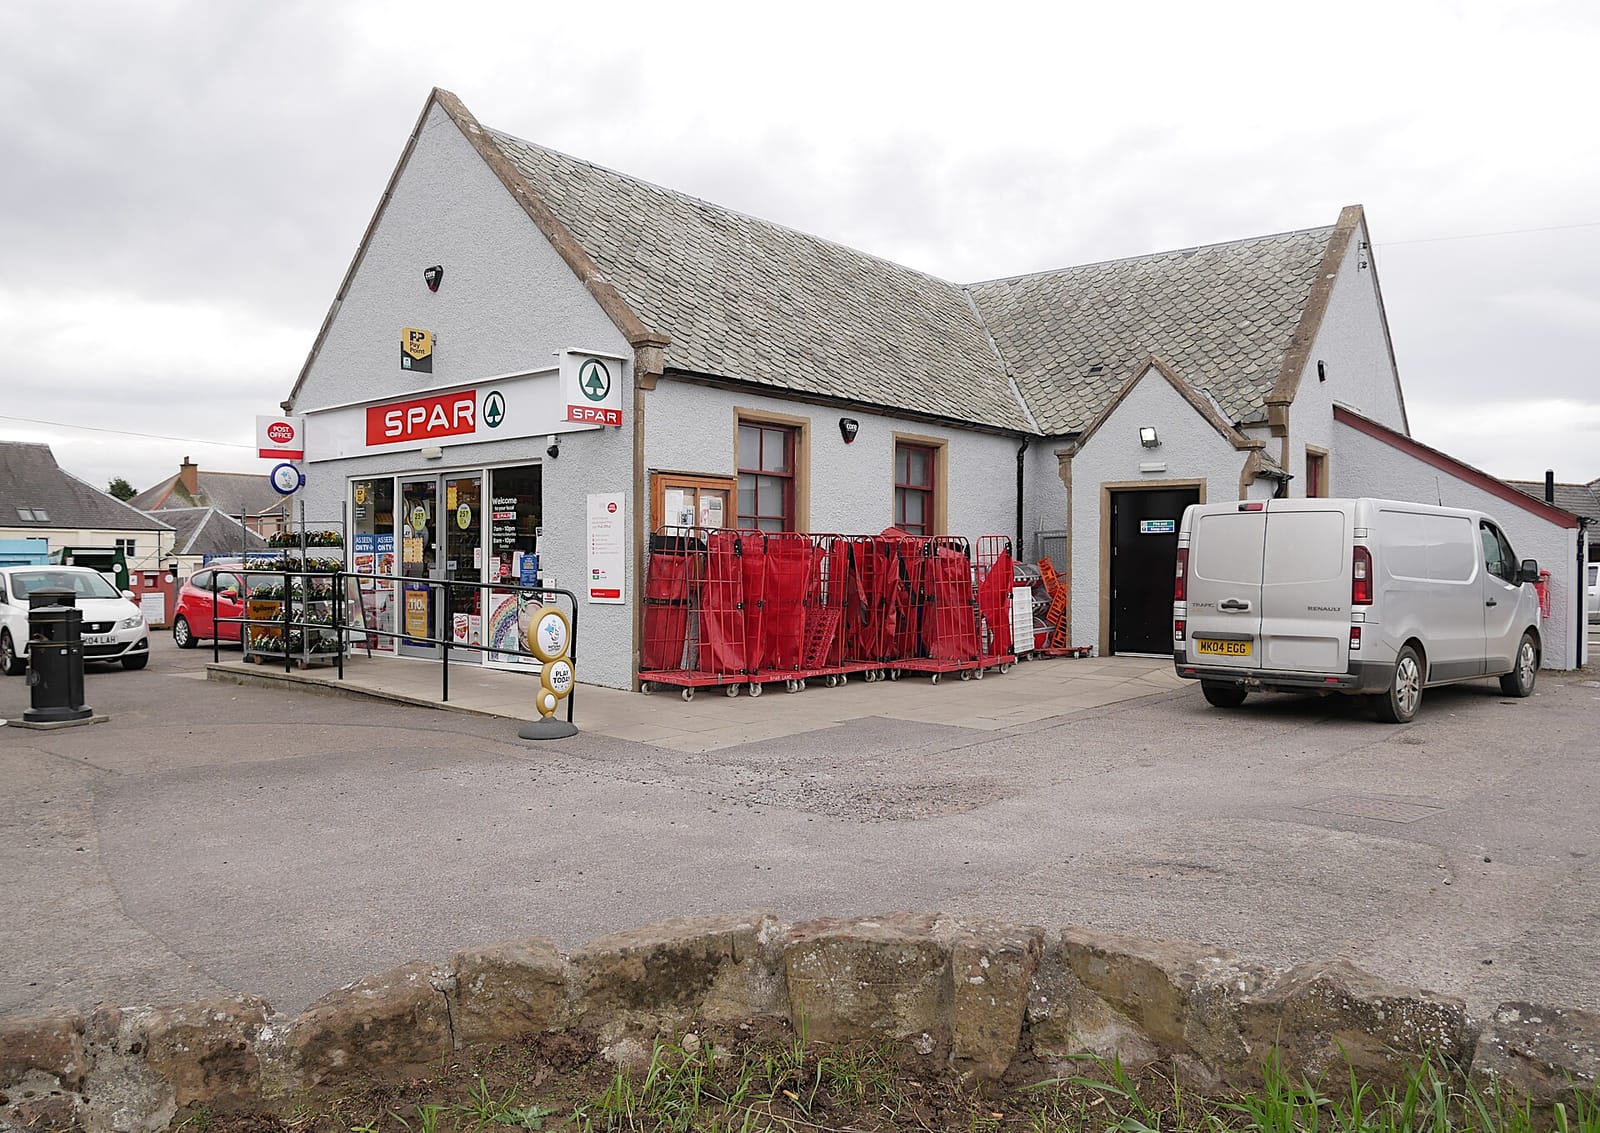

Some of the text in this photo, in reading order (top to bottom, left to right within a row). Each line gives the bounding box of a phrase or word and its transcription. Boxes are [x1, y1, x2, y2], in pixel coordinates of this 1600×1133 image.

[409, 347, 425, 355] Point
[384, 400, 474, 437] SPAR
[572, 408, 617, 423] SPAR
[1201, 641, 1246, 654] MK04 EGG
[553, 676, 570, 684] TODAY
